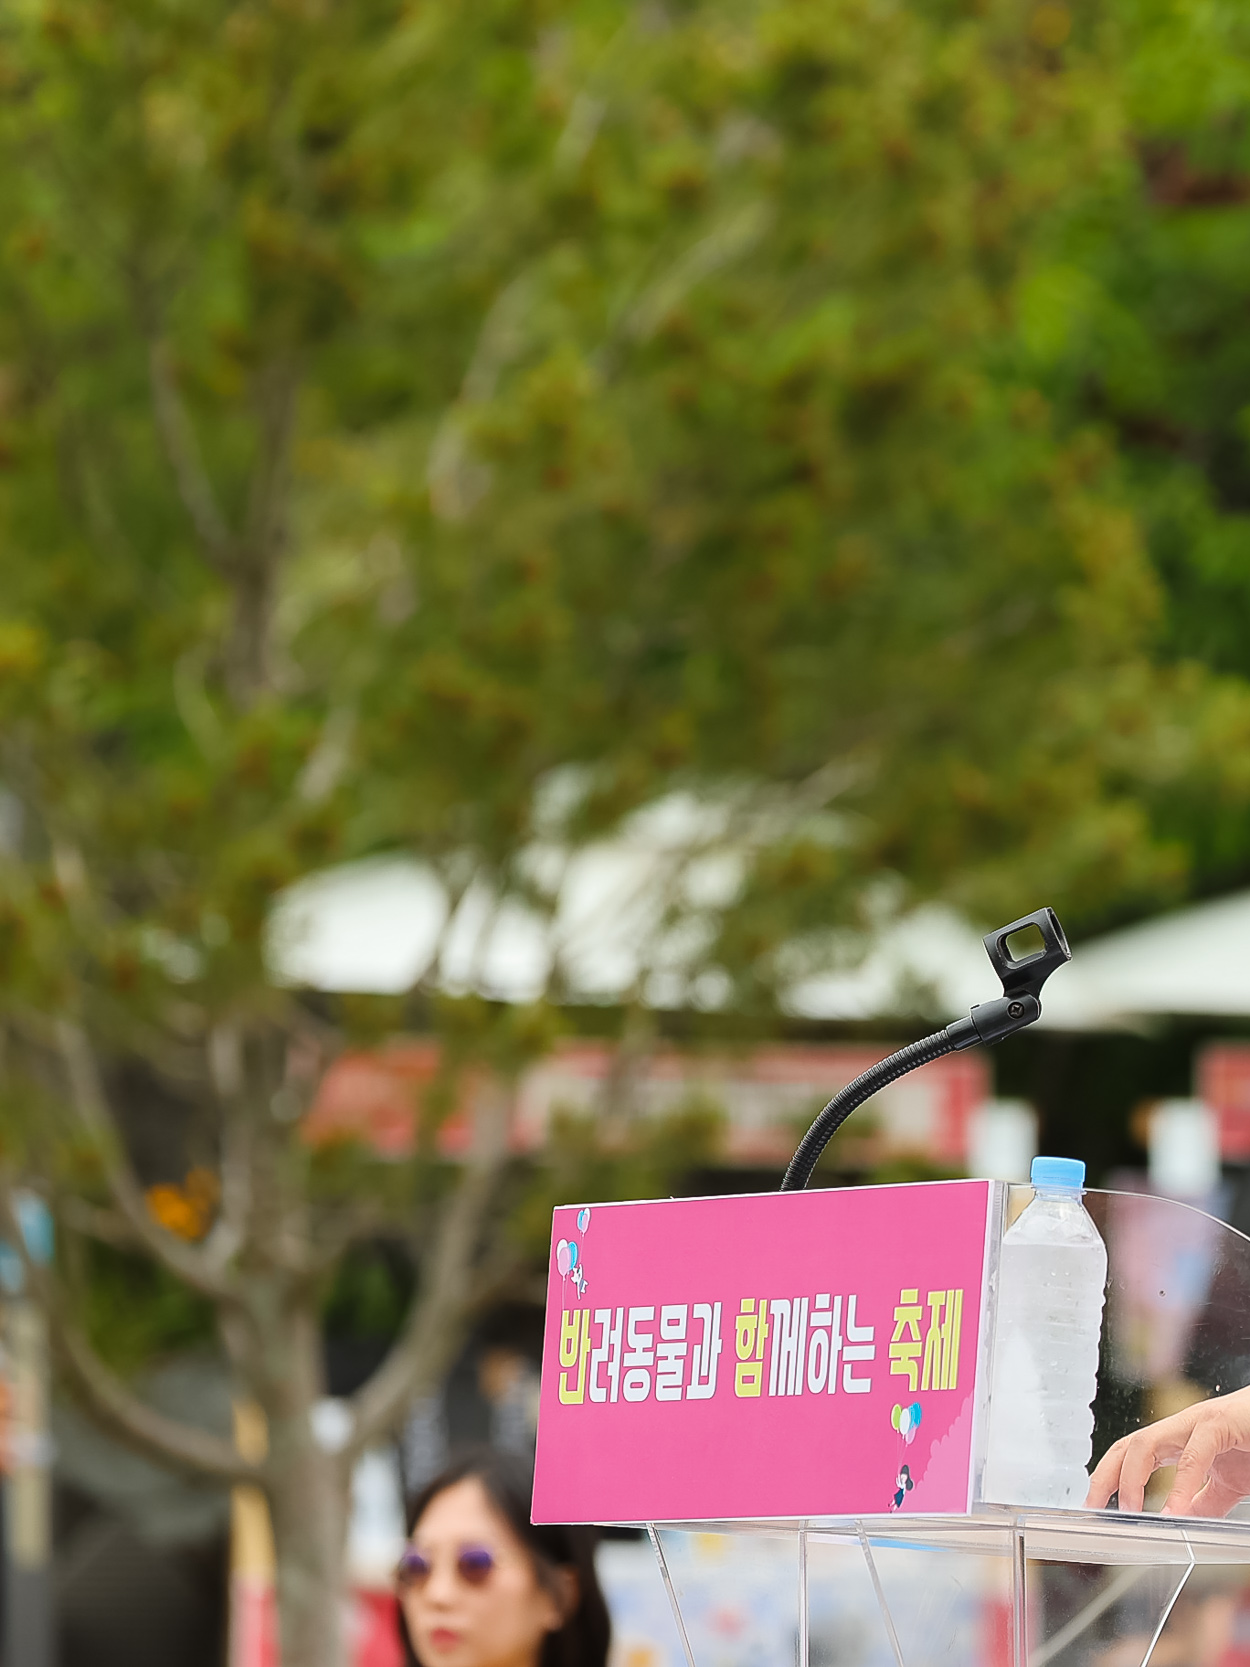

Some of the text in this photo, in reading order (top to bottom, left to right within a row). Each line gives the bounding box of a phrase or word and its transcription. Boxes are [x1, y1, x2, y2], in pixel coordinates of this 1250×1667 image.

[558, 1288, 964, 1405] 반려동물과 함께하는 축제
